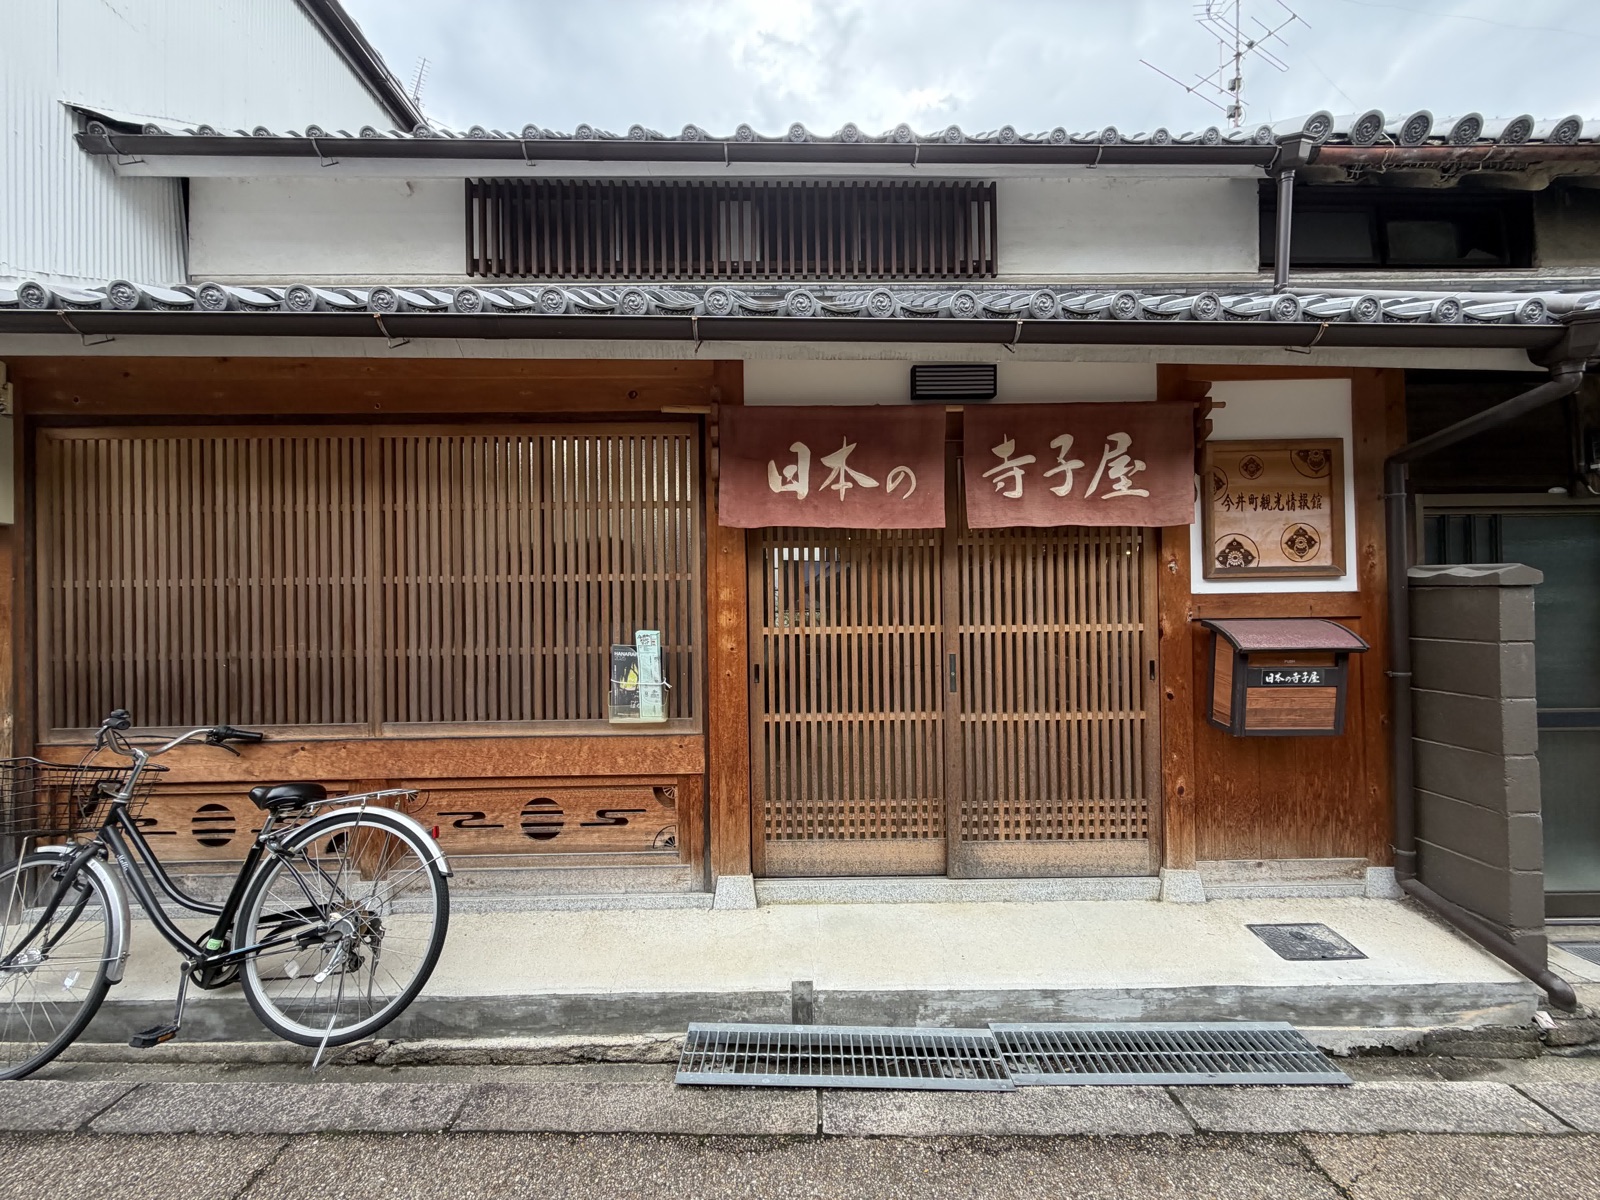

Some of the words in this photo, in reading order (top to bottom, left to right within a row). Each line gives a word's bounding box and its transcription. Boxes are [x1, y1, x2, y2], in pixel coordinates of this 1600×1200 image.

[767, 435, 917, 501] 日本の
[981, 431, 1151, 500] 寺子屋
[1221, 491, 1323, 512] 今井町観光情報館
[1265, 671, 1321, 684] 日本の寺子屋
